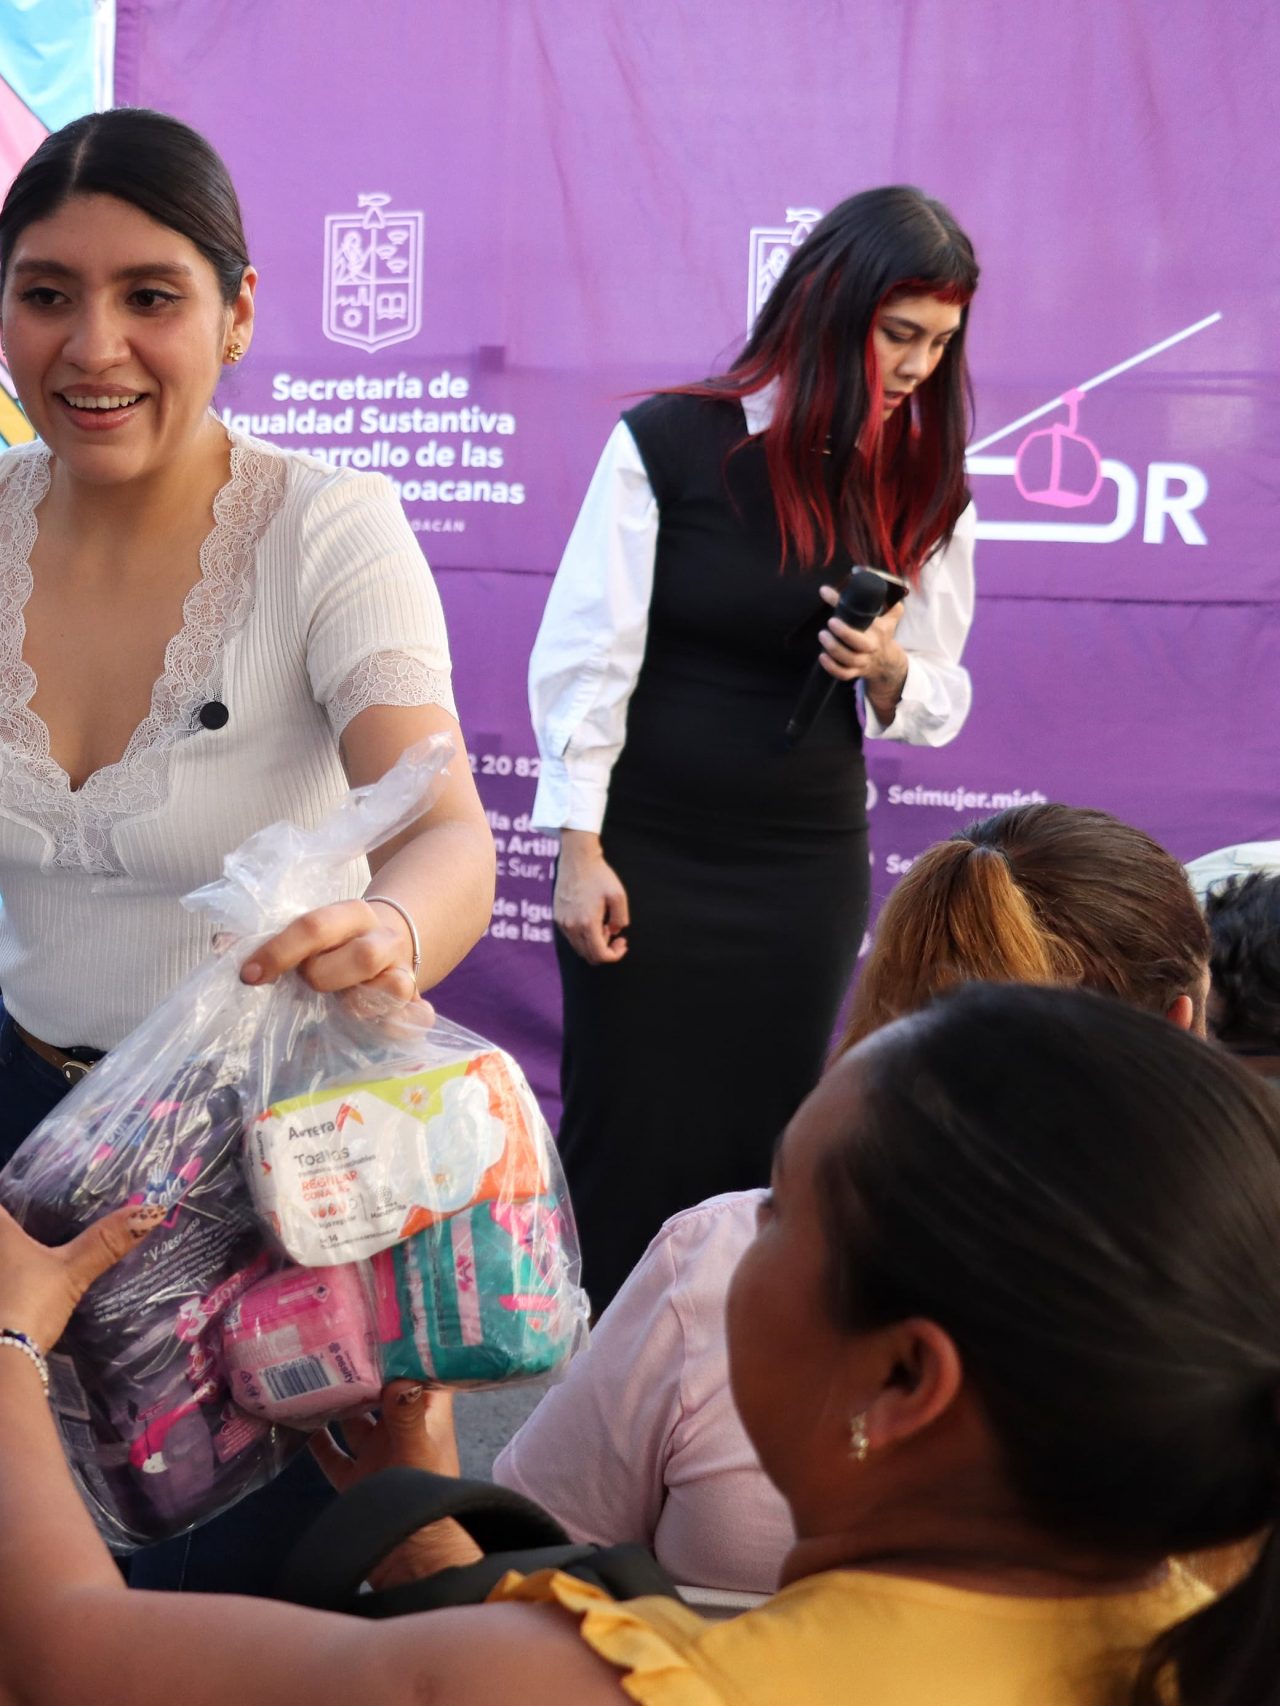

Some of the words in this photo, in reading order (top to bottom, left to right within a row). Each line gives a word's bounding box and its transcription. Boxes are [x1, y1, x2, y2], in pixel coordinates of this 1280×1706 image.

[272, 372, 422, 401] Secretaría
[428, 371, 469, 399] de
[223, 408, 354, 435] Igualdad
[360, 406, 516, 435] Sustantiva
[415, 441, 454, 468] de
[462, 441, 504, 468] las
[388, 476, 526, 504] oacanas
[481, 754, 513, 776] 20
[492, 897, 519, 918] de
[490, 919, 519, 940] de
[522, 921, 553, 943] las
